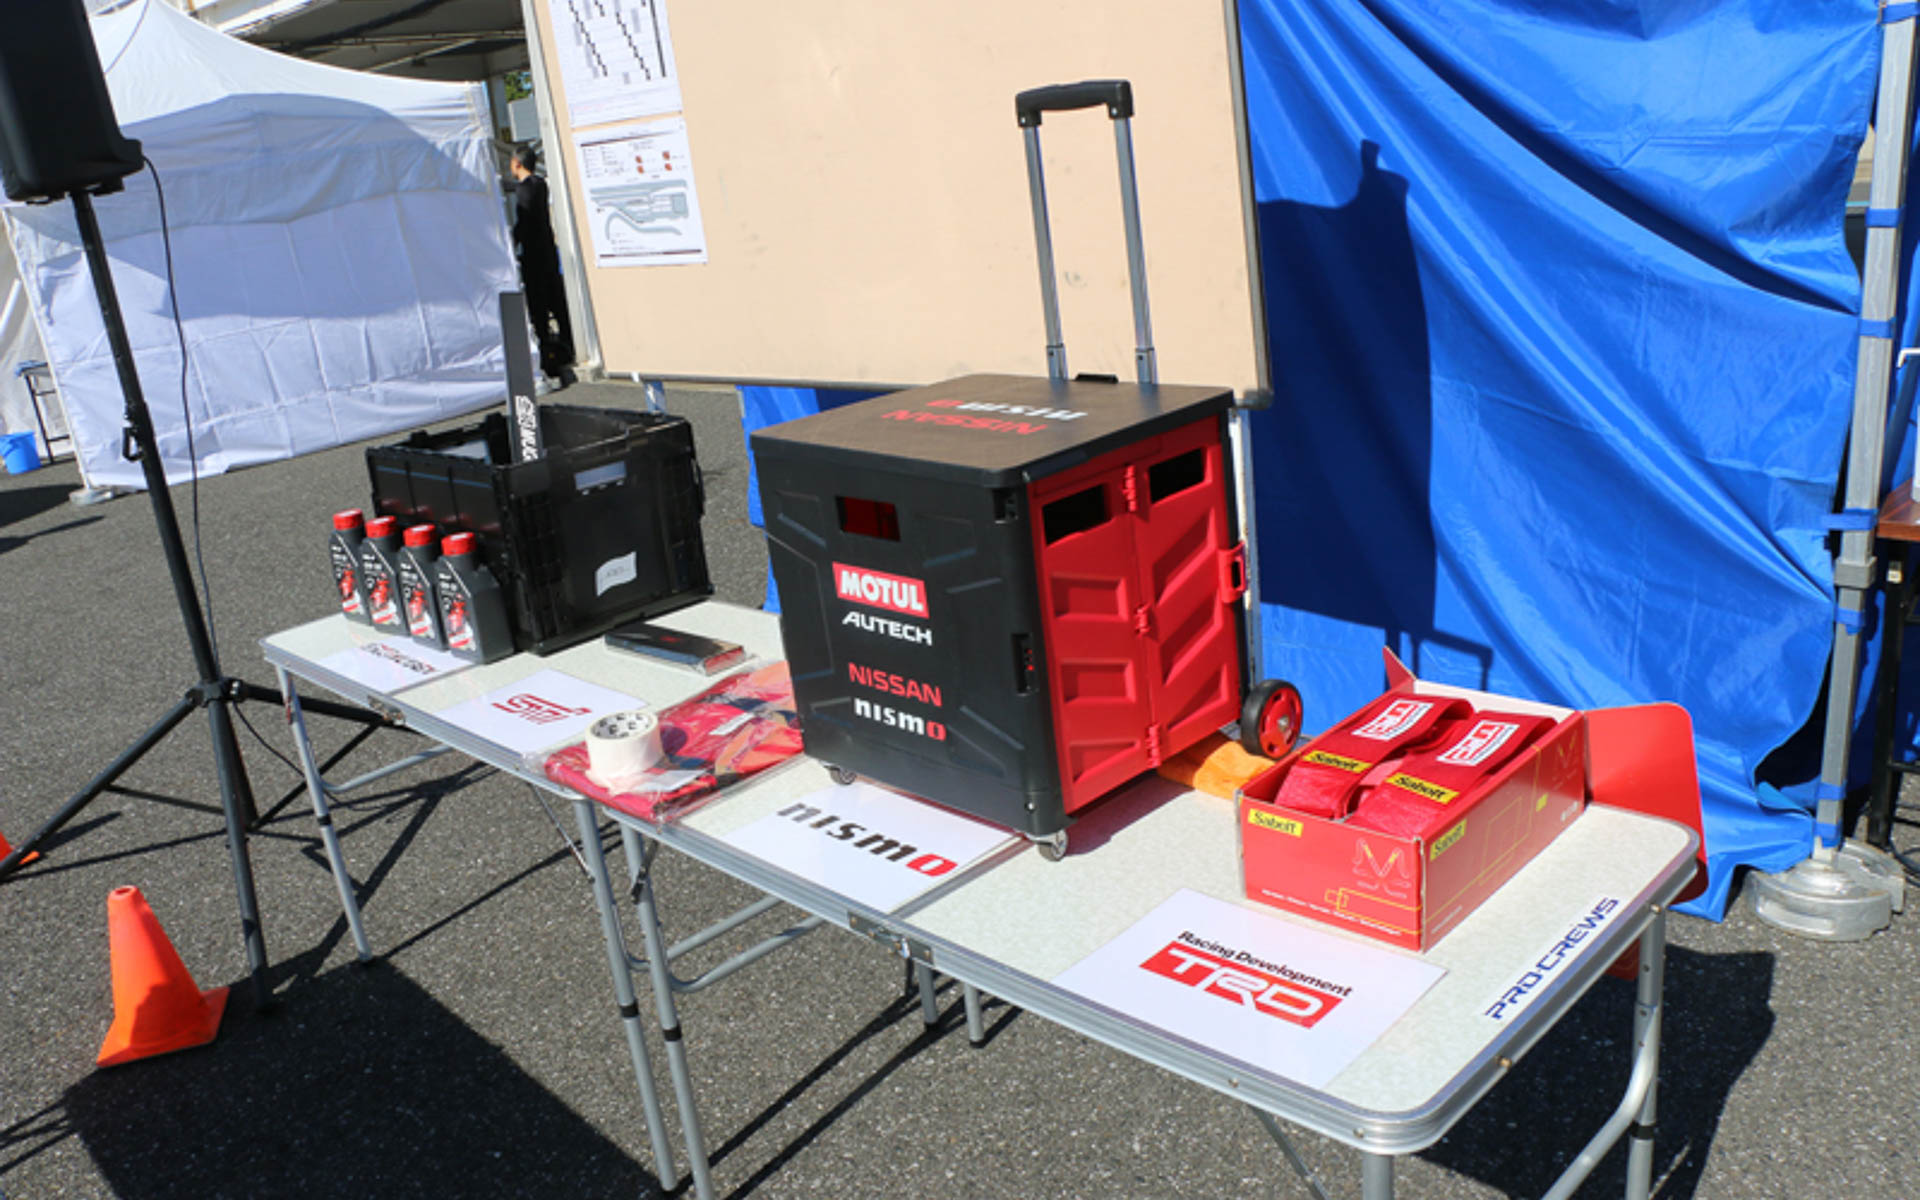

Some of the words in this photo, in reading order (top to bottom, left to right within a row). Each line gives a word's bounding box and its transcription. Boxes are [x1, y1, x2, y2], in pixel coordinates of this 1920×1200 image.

[881, 409, 1048, 435] NISSAN
[840, 569, 925, 613] MOTUL
[842, 611, 933, 646] AUTECH
[848, 662, 943, 707] NISSAN
[854, 697, 947, 741] nismo
[777, 802, 959, 878] nismo
[1166, 946, 1325, 1019] TRD
[1176, 930, 1236, 960] Racing
[1234, 950, 1353, 998] Development
